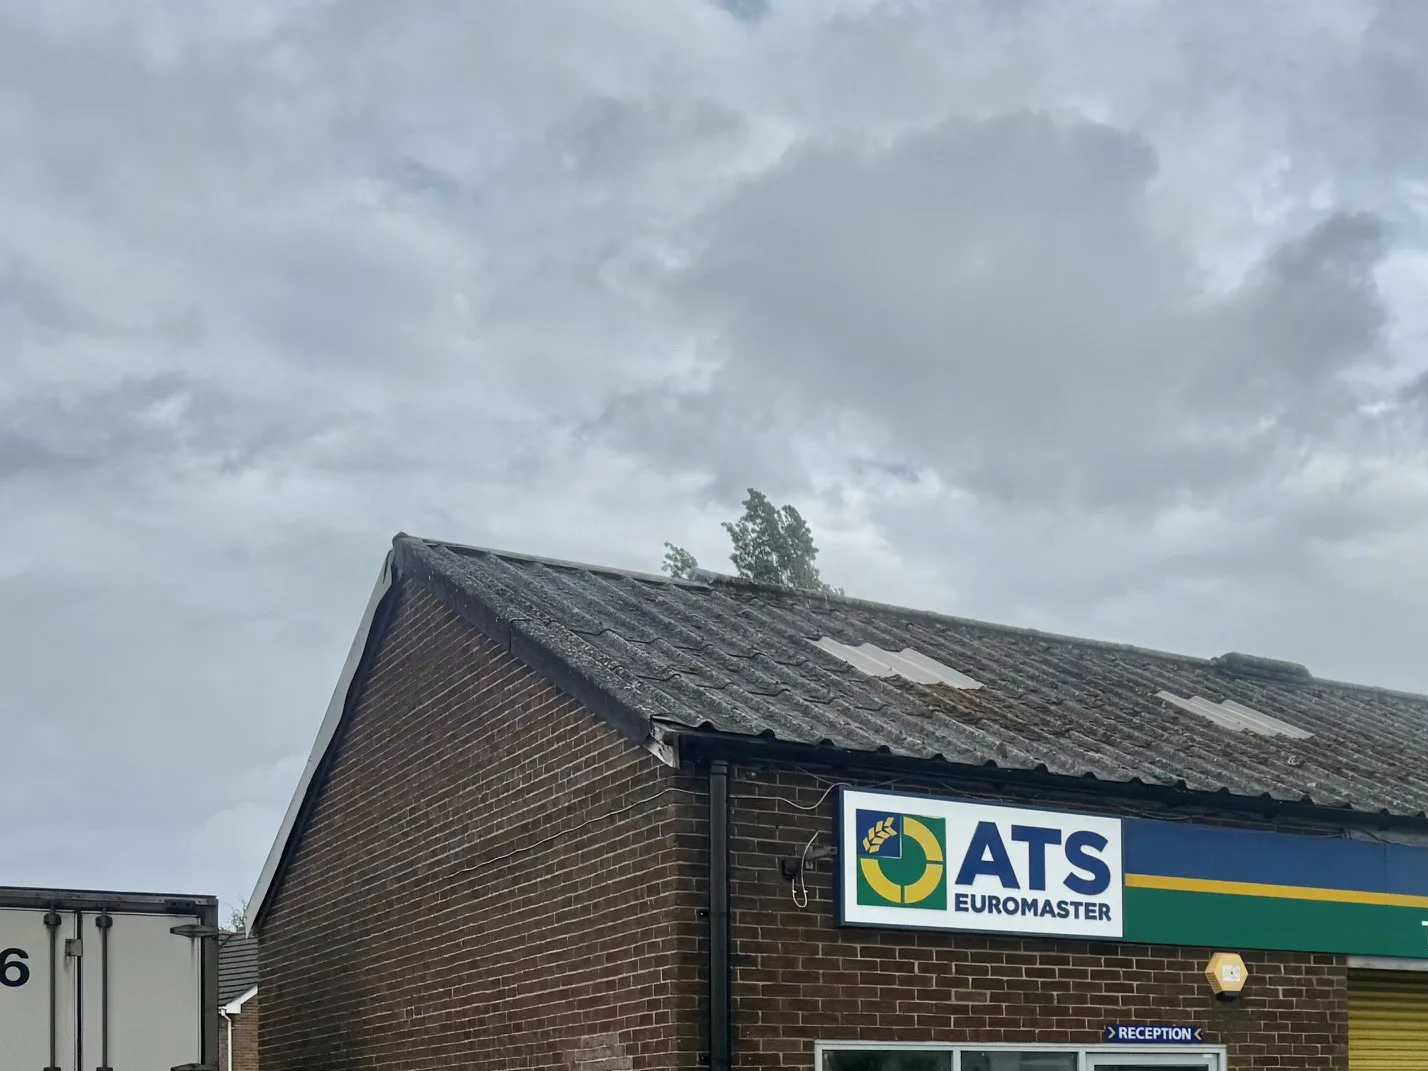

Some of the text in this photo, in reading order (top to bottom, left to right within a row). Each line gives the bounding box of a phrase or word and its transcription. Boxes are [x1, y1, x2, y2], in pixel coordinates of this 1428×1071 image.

[955, 820, 1112, 896] ATS
[954, 892, 1112, 922] EUROMASTER
[0, 947, 30, 988] 6
[1118, 1026, 1192, 1040] RECEPTION
